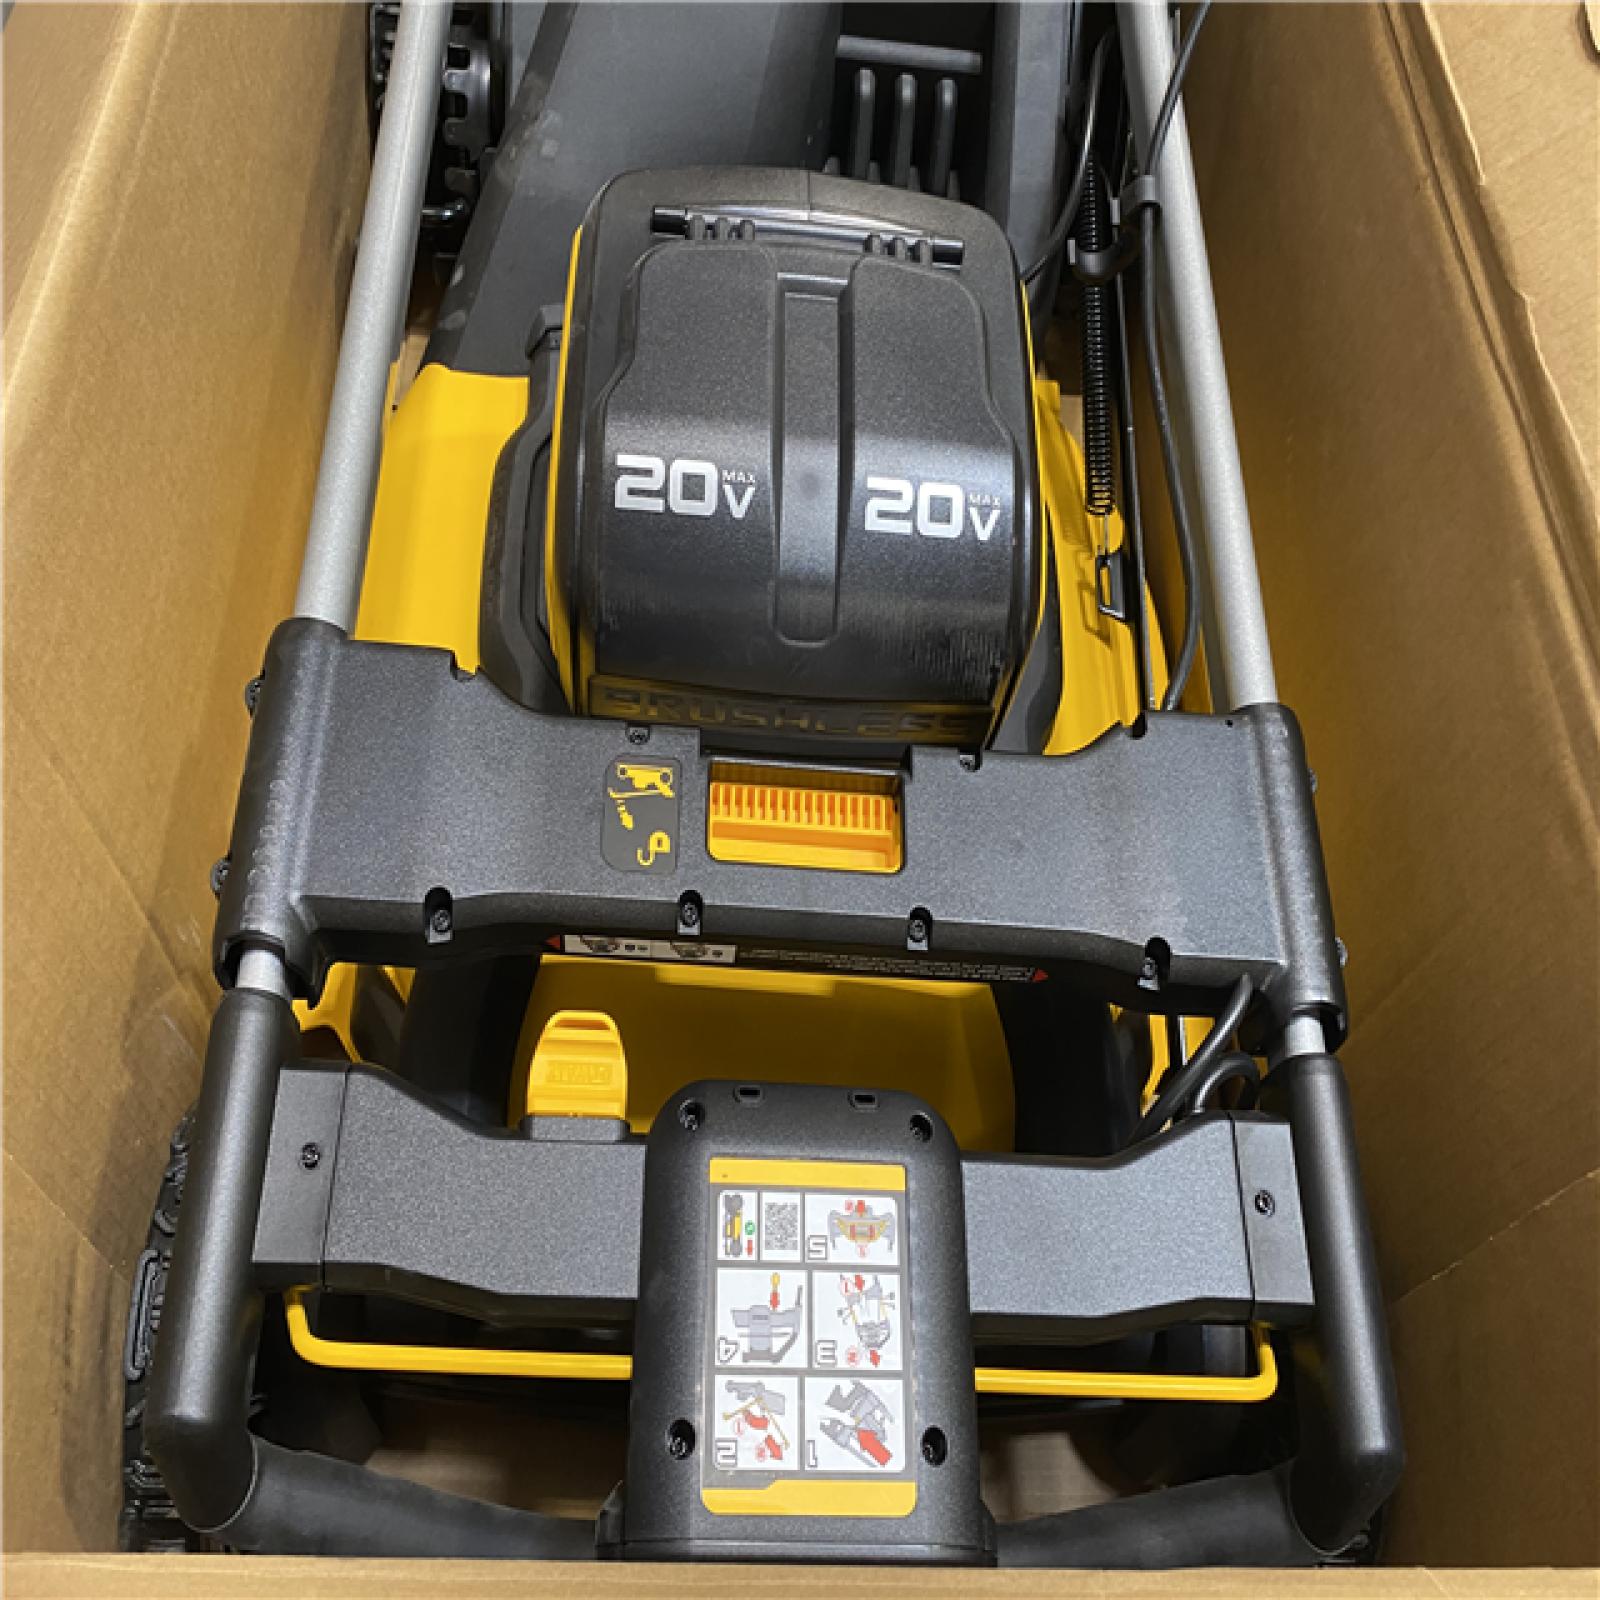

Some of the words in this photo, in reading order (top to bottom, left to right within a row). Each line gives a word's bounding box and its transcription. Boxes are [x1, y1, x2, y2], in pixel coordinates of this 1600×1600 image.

[722, 469, 756, 485] MAX
[970, 494, 1000, 506] MAX
[808, 1235, 828, 1261] 5
[718, 1337, 739, 1363] 4
[816, 1340, 837, 1366] 3
[716, 1438, 737, 1467] 2
[808, 1440, 818, 1468] 1
